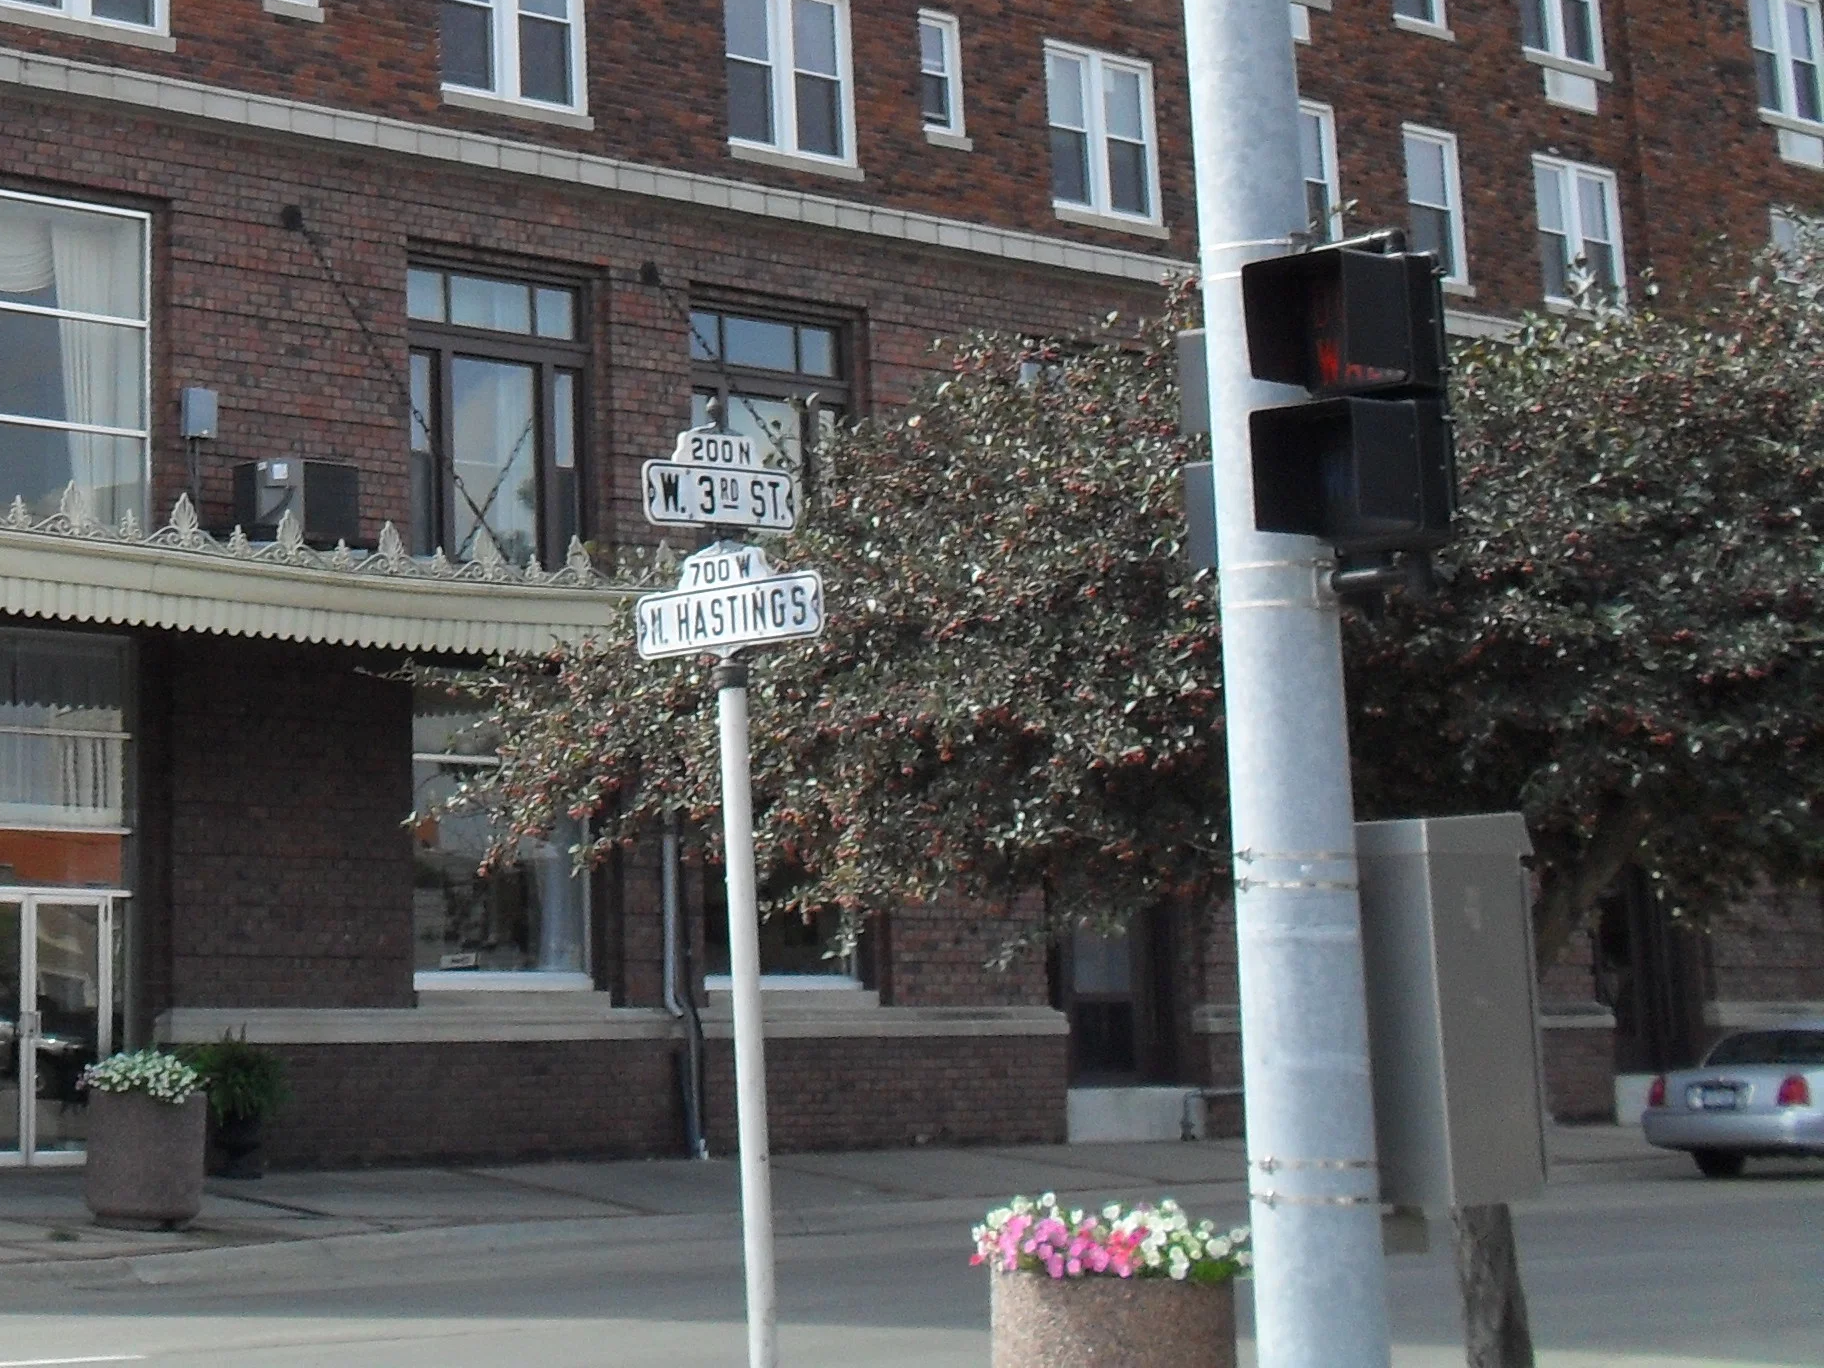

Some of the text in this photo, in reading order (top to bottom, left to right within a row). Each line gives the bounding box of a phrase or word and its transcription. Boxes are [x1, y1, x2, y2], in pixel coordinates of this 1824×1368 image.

[691, 437, 751, 465] 200 N
[660, 472, 686, 514] W.
[751, 480, 786, 521] ST.
[690, 554, 751, 586] 700 W
[677, 585, 807, 642] HASTINGS
